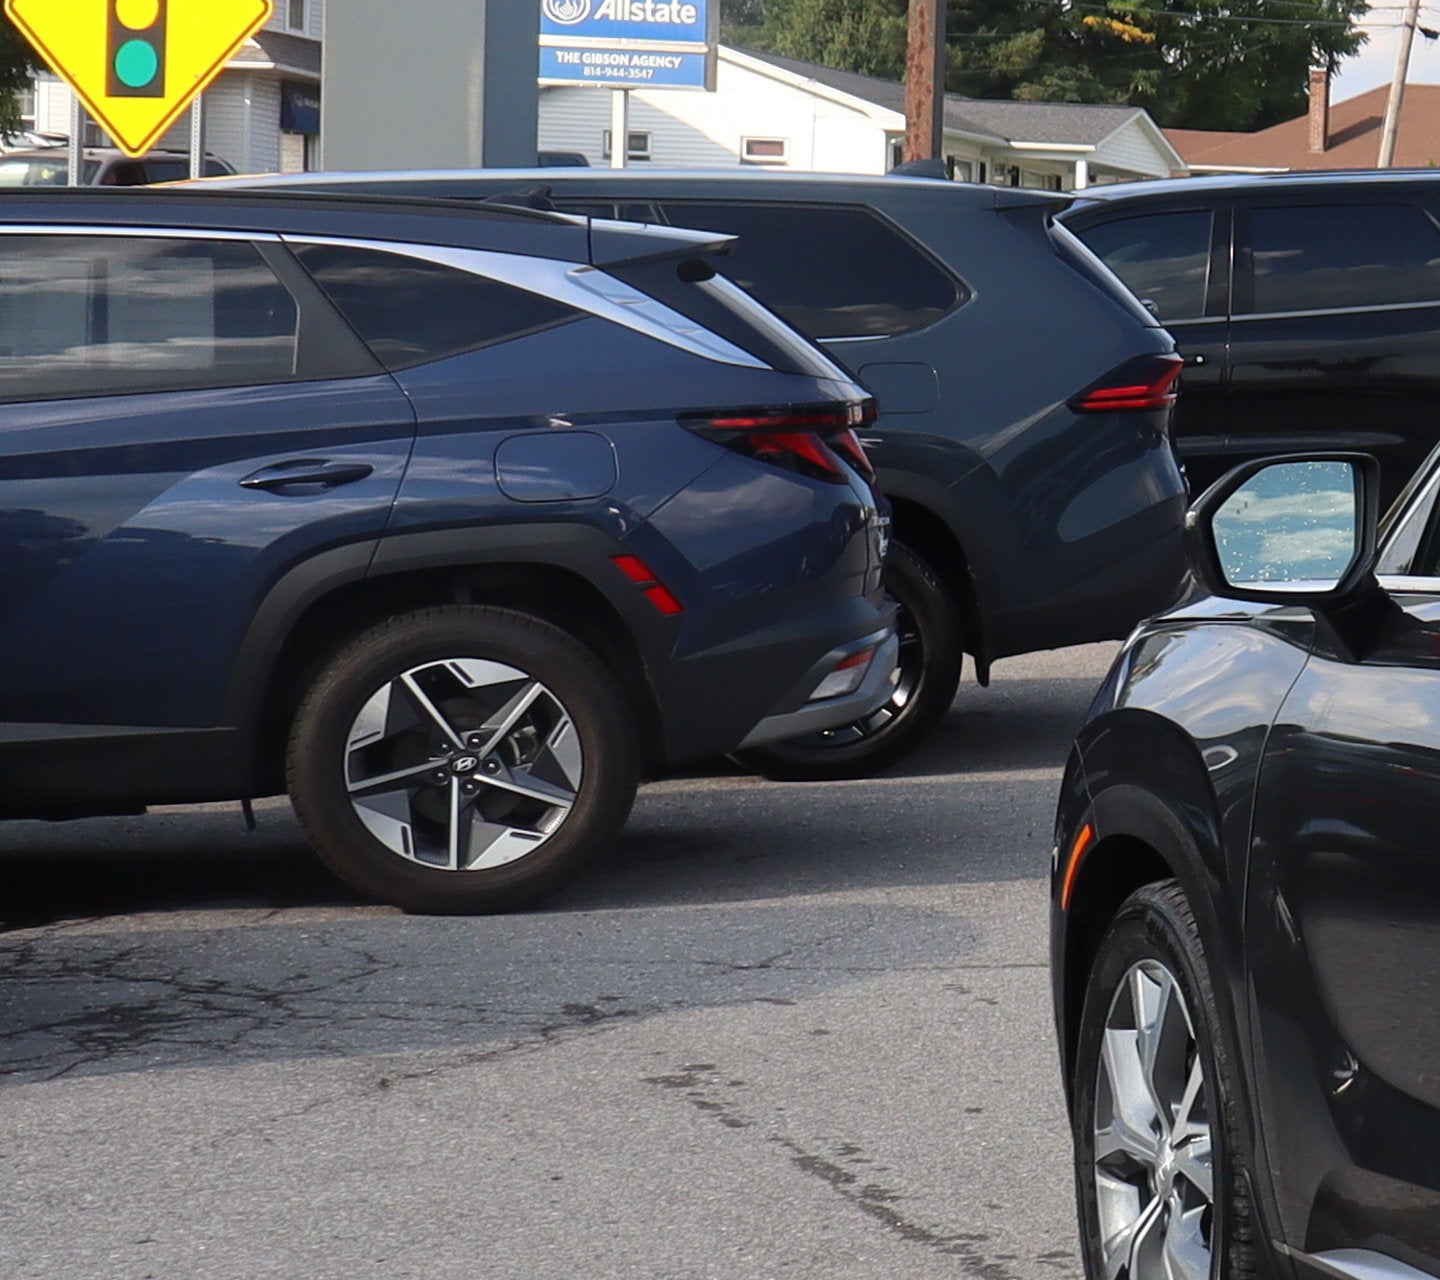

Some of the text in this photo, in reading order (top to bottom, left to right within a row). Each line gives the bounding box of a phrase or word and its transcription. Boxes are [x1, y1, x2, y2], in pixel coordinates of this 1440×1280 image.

[555, 51, 682, 69] THE GIBSON AGENCY
[583, 66, 654, 79] 814-944-3547
